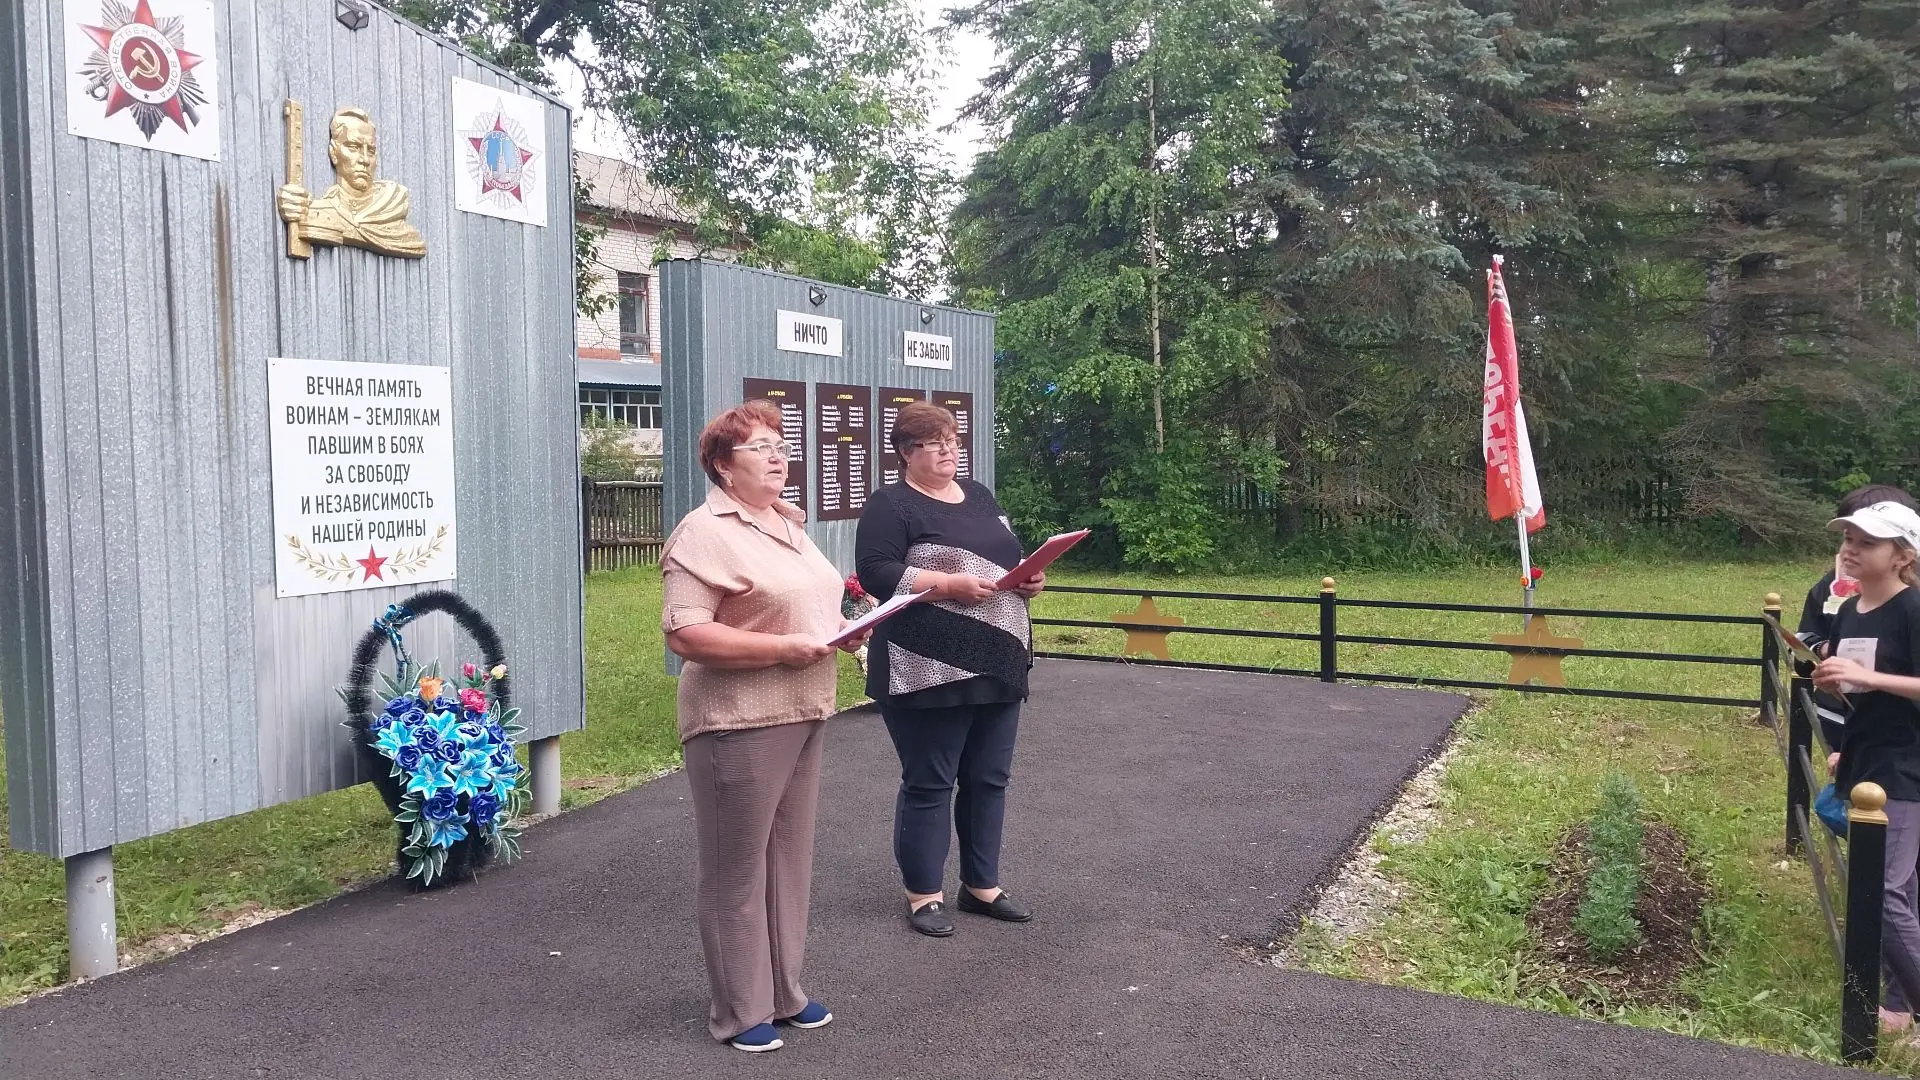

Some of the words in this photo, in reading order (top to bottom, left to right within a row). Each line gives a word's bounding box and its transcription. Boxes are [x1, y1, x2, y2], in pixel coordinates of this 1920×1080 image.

[794, 321, 828, 346] НИЧТО
[907, 339, 918, 358] НЕ
[919, 341, 950, 362] ЗАБЫТО
[306, 375, 364, 397] ВЕЧНАЯ
[368, 378, 422, 398] ПАМЯТЬ
[286, 405, 349, 426] ВОИНАМ
[366, 406, 441, 427] ЗЕМЛЯКАМ
[308, 435, 373, 455] ПАВШИМ
[378, 436, 386, 454] В
[390, 435, 425, 454] БОЯХ
[325, 465, 344, 484] ЗА
[348, 463, 411, 485] СВОБОДУ
[301, 495, 311, 515] И
[315, 490, 434, 514] НЕЗАВИСИМОСТЬ
[312, 518, 364, 544] НАШЕЙ
[368, 518, 426, 542] РОДИНЫ
